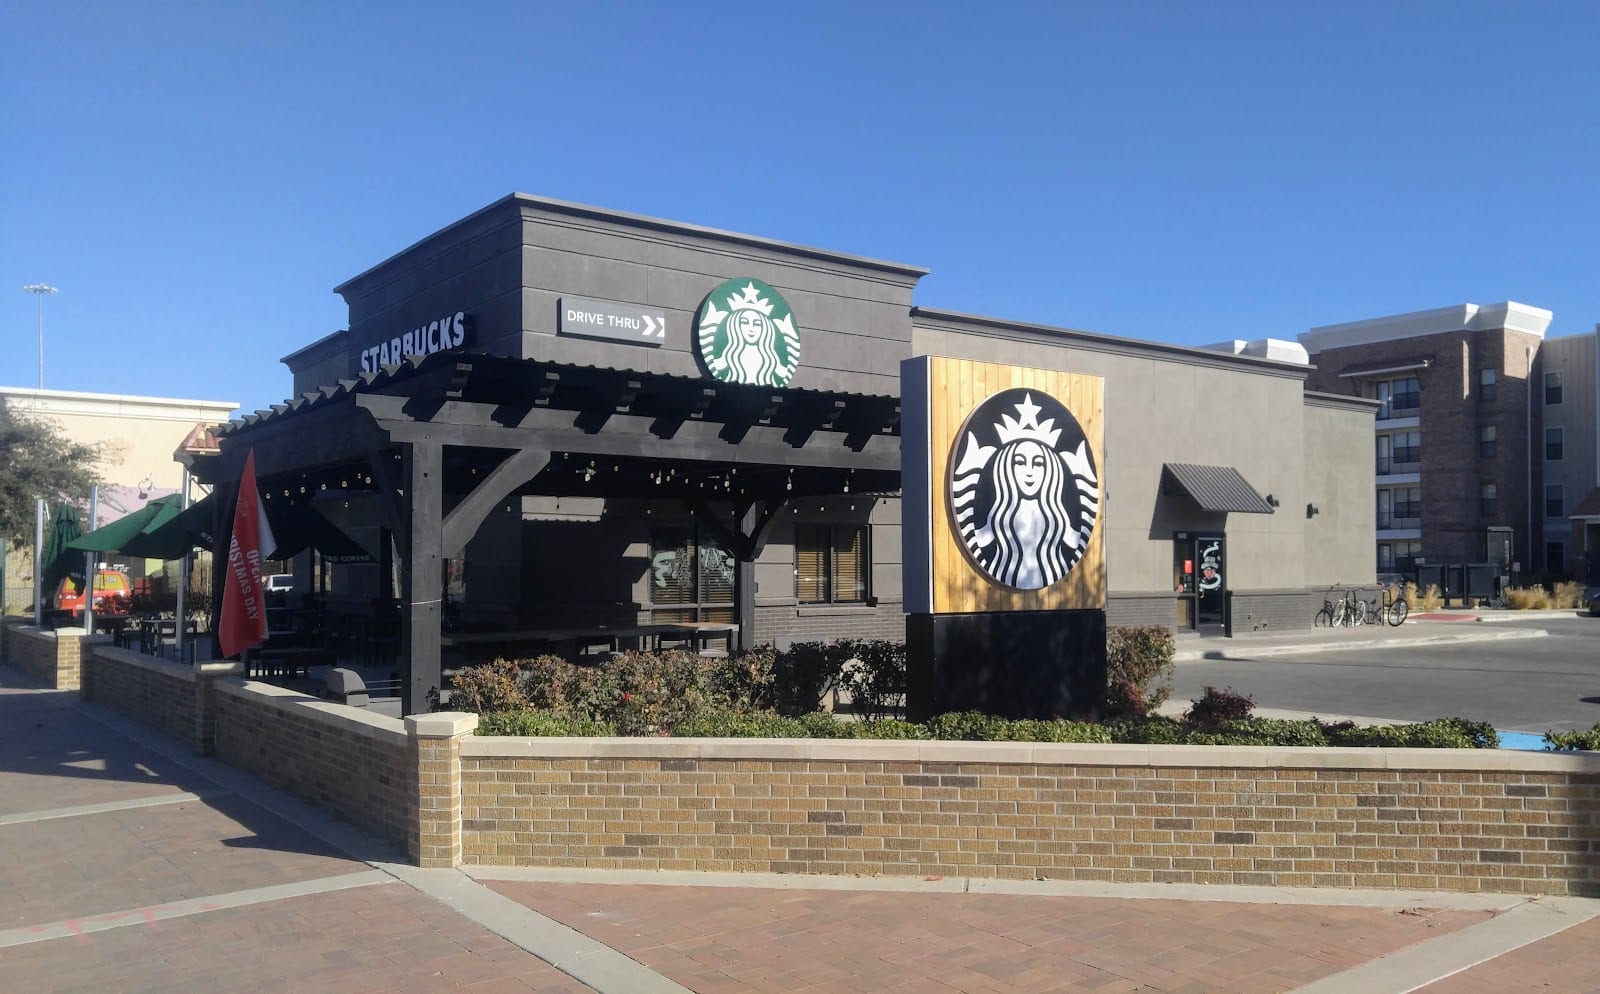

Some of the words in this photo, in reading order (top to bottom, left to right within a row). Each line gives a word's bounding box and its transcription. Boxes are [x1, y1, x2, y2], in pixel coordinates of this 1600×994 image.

[567, 309, 604, 325] DRIVE
[607, 315, 640, 330] THRU
[361, 311, 465, 373] STARBUCKS
[244, 595, 260, 621] DAY
